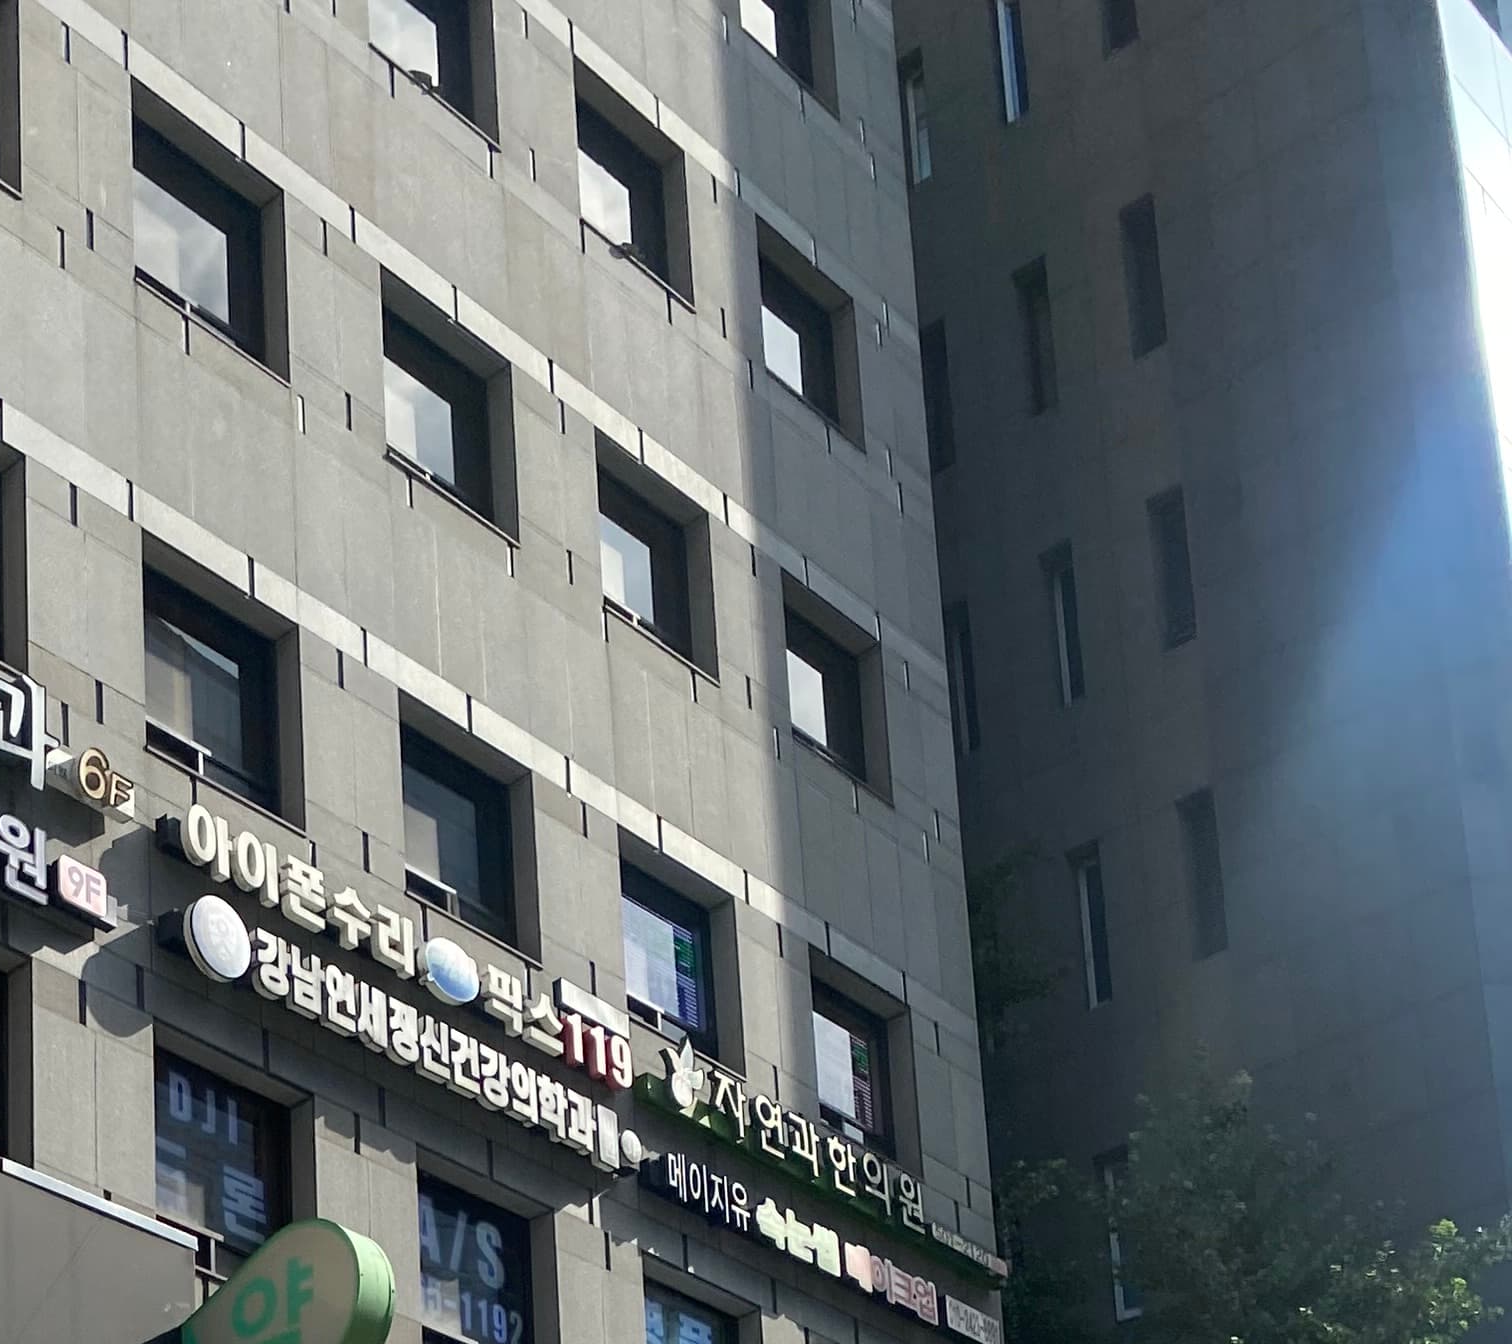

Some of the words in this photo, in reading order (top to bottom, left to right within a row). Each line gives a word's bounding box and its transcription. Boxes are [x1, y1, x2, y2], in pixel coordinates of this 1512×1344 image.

[77, 747, 135, 808] 6F
[67, 866, 102, 909] 9F
[185, 803, 416, 980] 아이폰수리
[485, 963, 634, 1091] 픽스119
[667, 1152, 752, 1232] 메이지유
